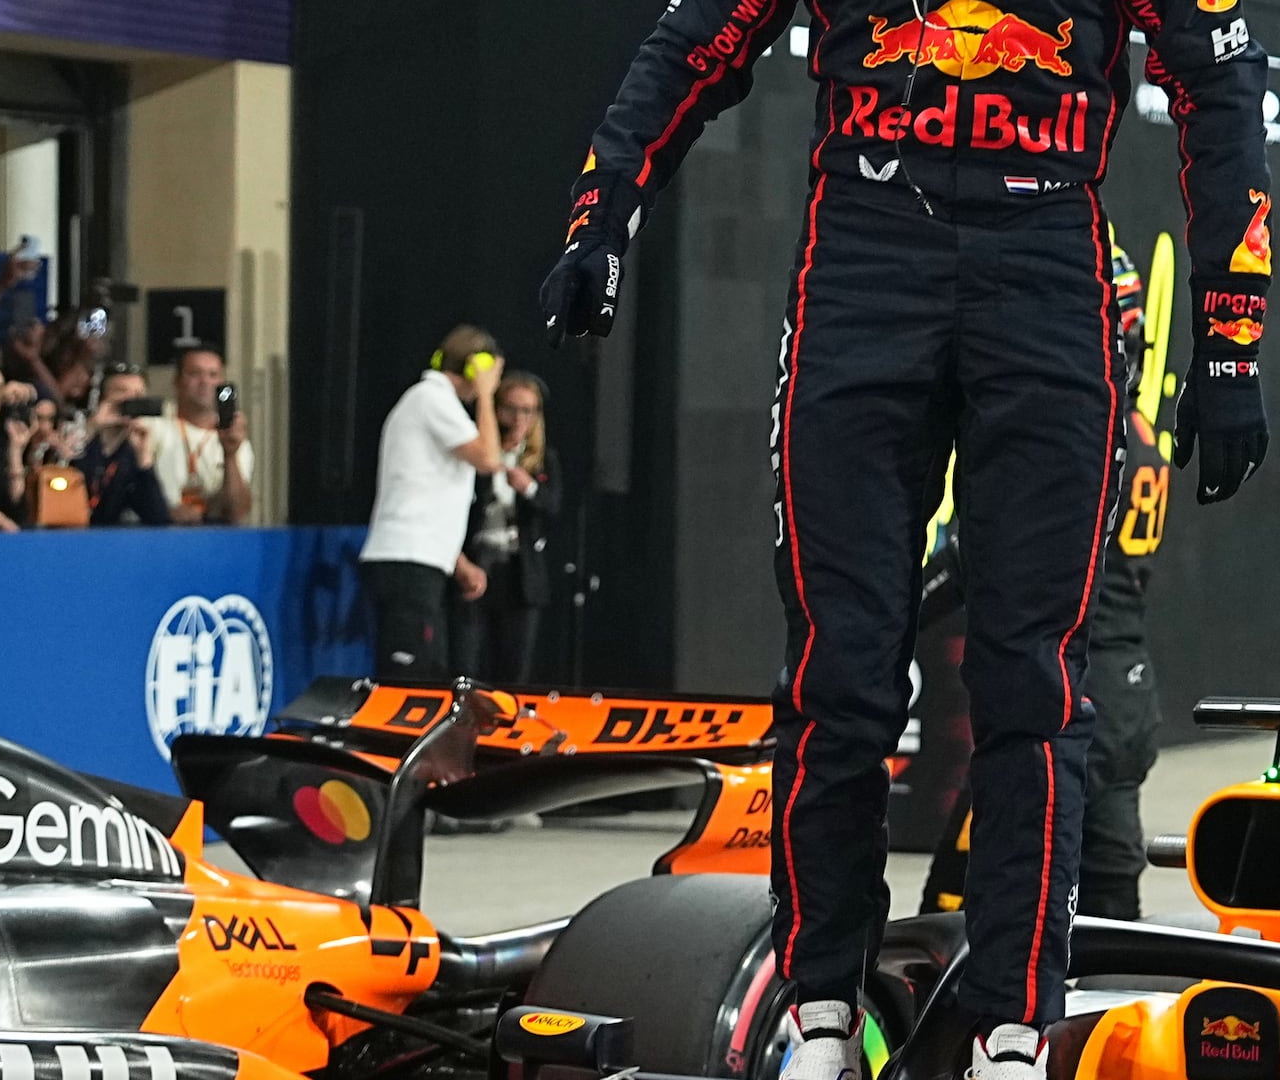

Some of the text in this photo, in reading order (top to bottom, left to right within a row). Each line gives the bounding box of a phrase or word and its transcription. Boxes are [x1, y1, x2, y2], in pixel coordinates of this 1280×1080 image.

[842, 85, 960, 148] Red
[970, 91, 1088, 152] Bull
[172, 305, 202, 348] 1
[724, 827, 773, 849] Das
[203, 914, 298, 952] DELL
[222, 959, 302, 986] Technologies
[1200, 1040, 1260, 1062] Red Bull
